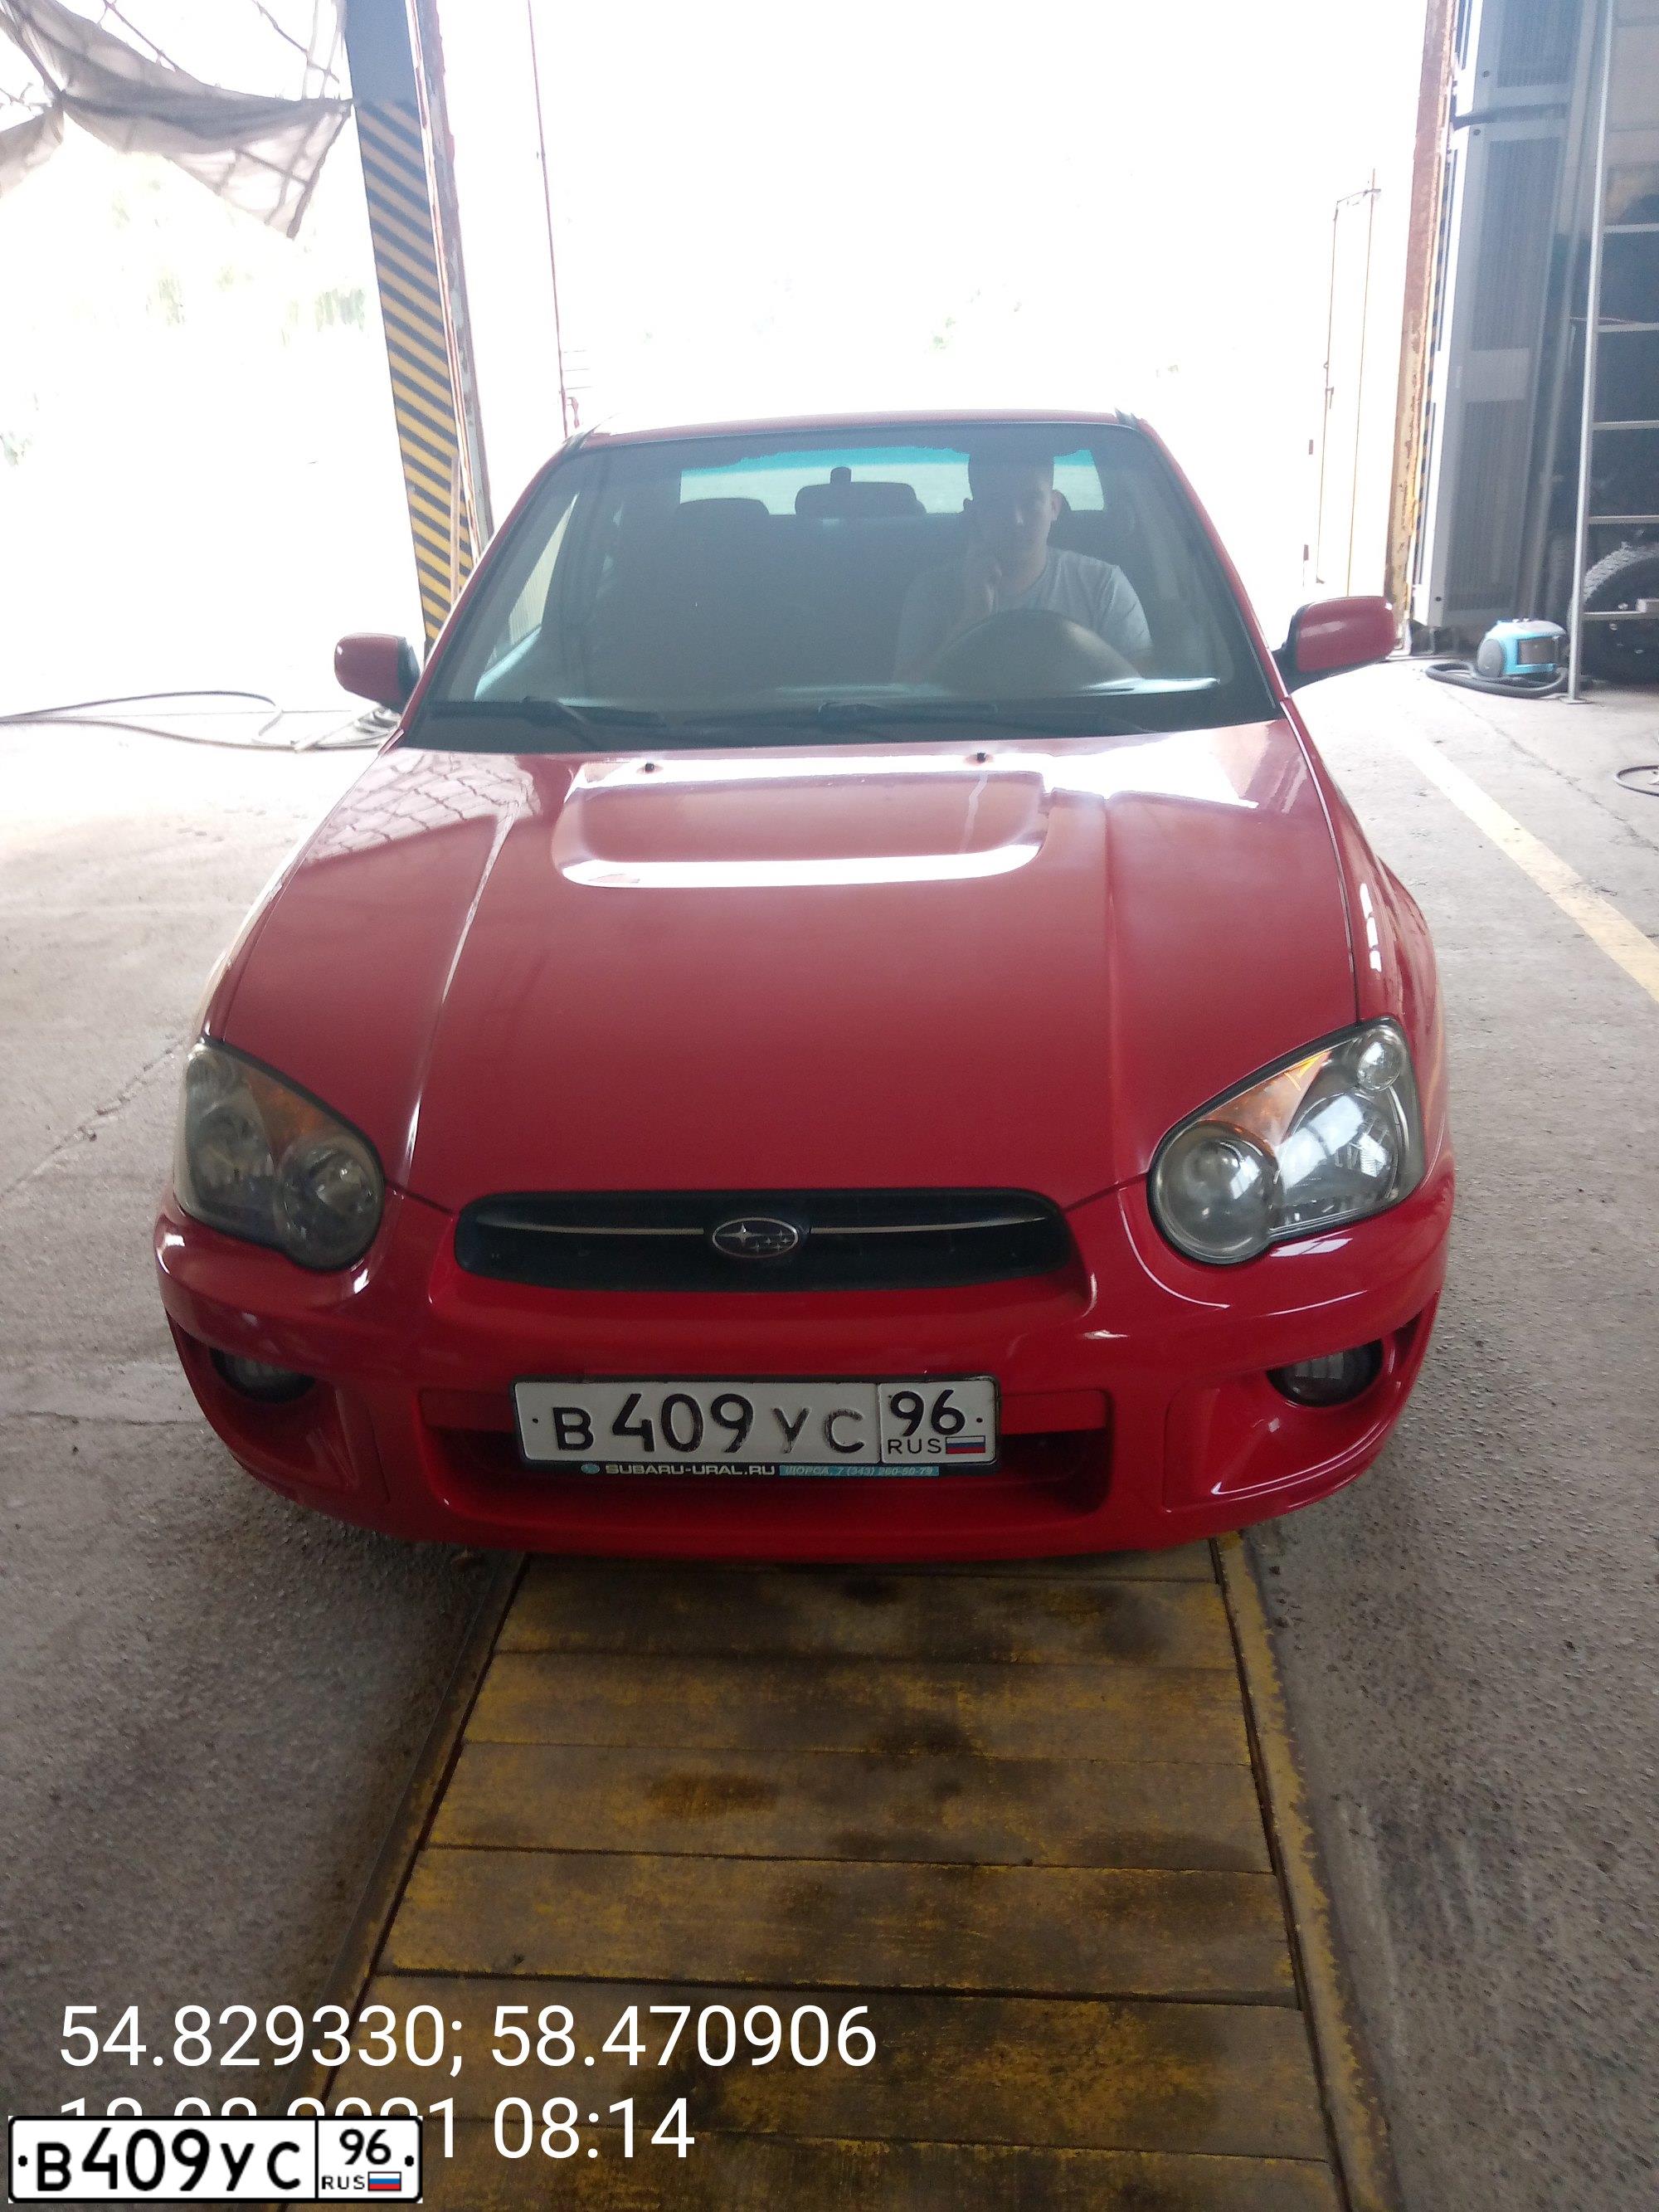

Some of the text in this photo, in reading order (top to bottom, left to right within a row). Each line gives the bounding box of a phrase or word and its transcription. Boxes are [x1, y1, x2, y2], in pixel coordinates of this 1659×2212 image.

[889, 1389, 966, 1436] 96
[888, 1437, 942, 1454] RUS
[605, 1464, 776, 1475] SUBARU-URAL.RU
